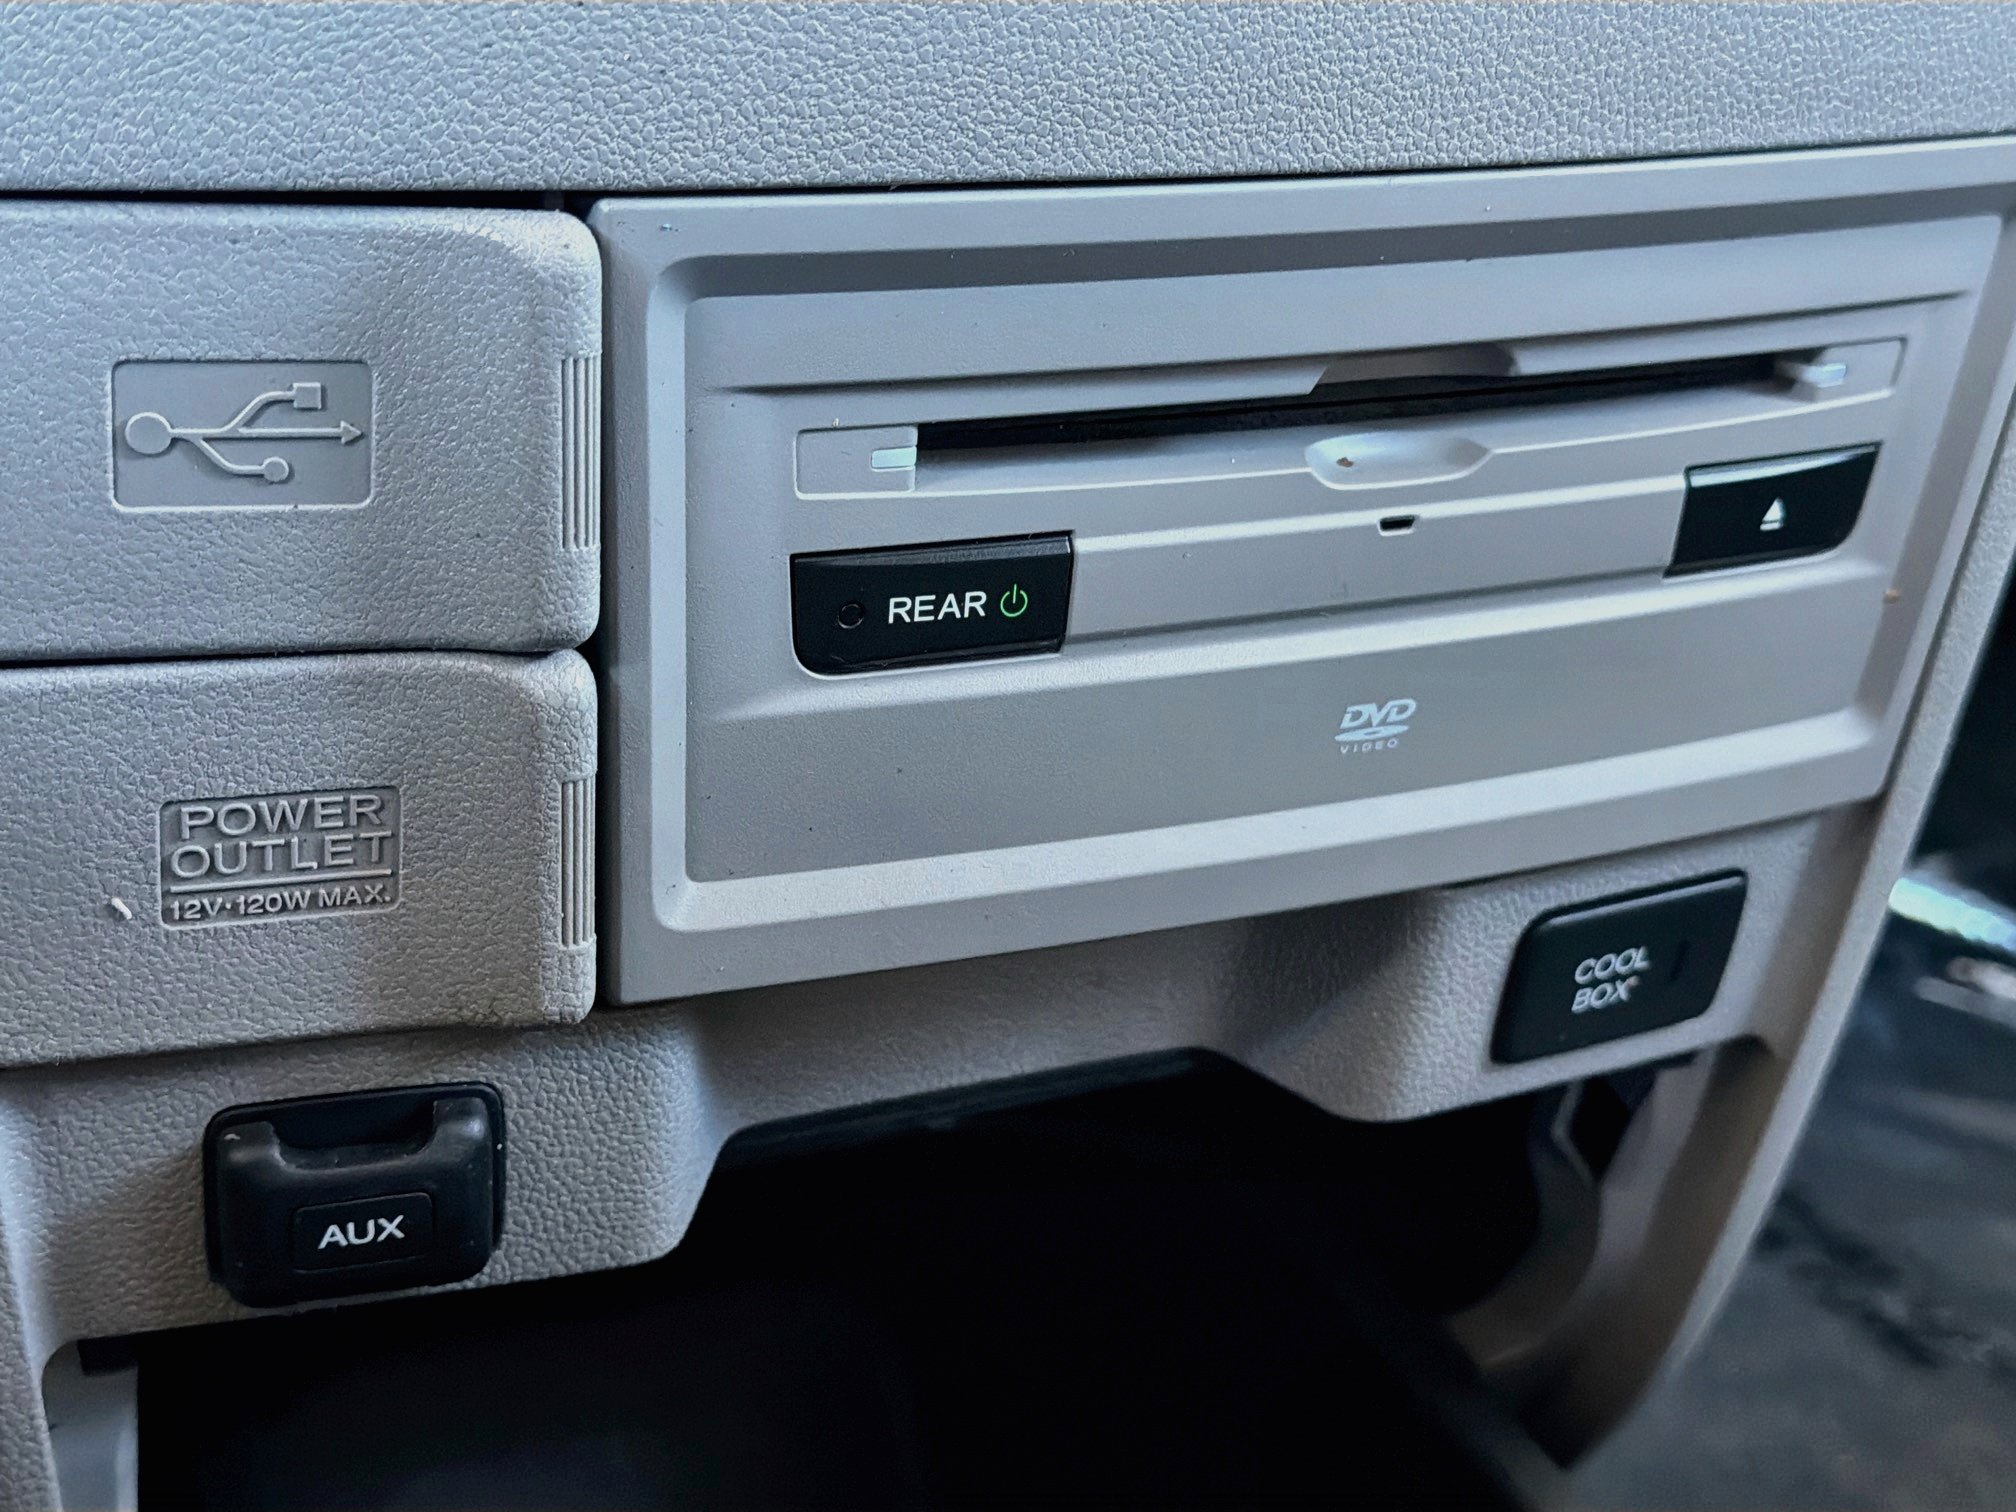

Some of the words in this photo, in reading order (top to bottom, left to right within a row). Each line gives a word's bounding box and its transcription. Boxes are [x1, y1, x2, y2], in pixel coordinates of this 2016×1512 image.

[888, 591, 987, 624] REAR
[1340, 698, 1416, 729] DVD
[1340, 738, 1398, 754] VIDEO
[180, 794, 383, 840] POWER
[170, 830, 392, 878] OUTLET
[318, 883, 391, 908] MAX.
[1574, 945, 1651, 985] COOL
[1571, 975, 1640, 1014] BOX
[317, 1214, 405, 1250] AUX
